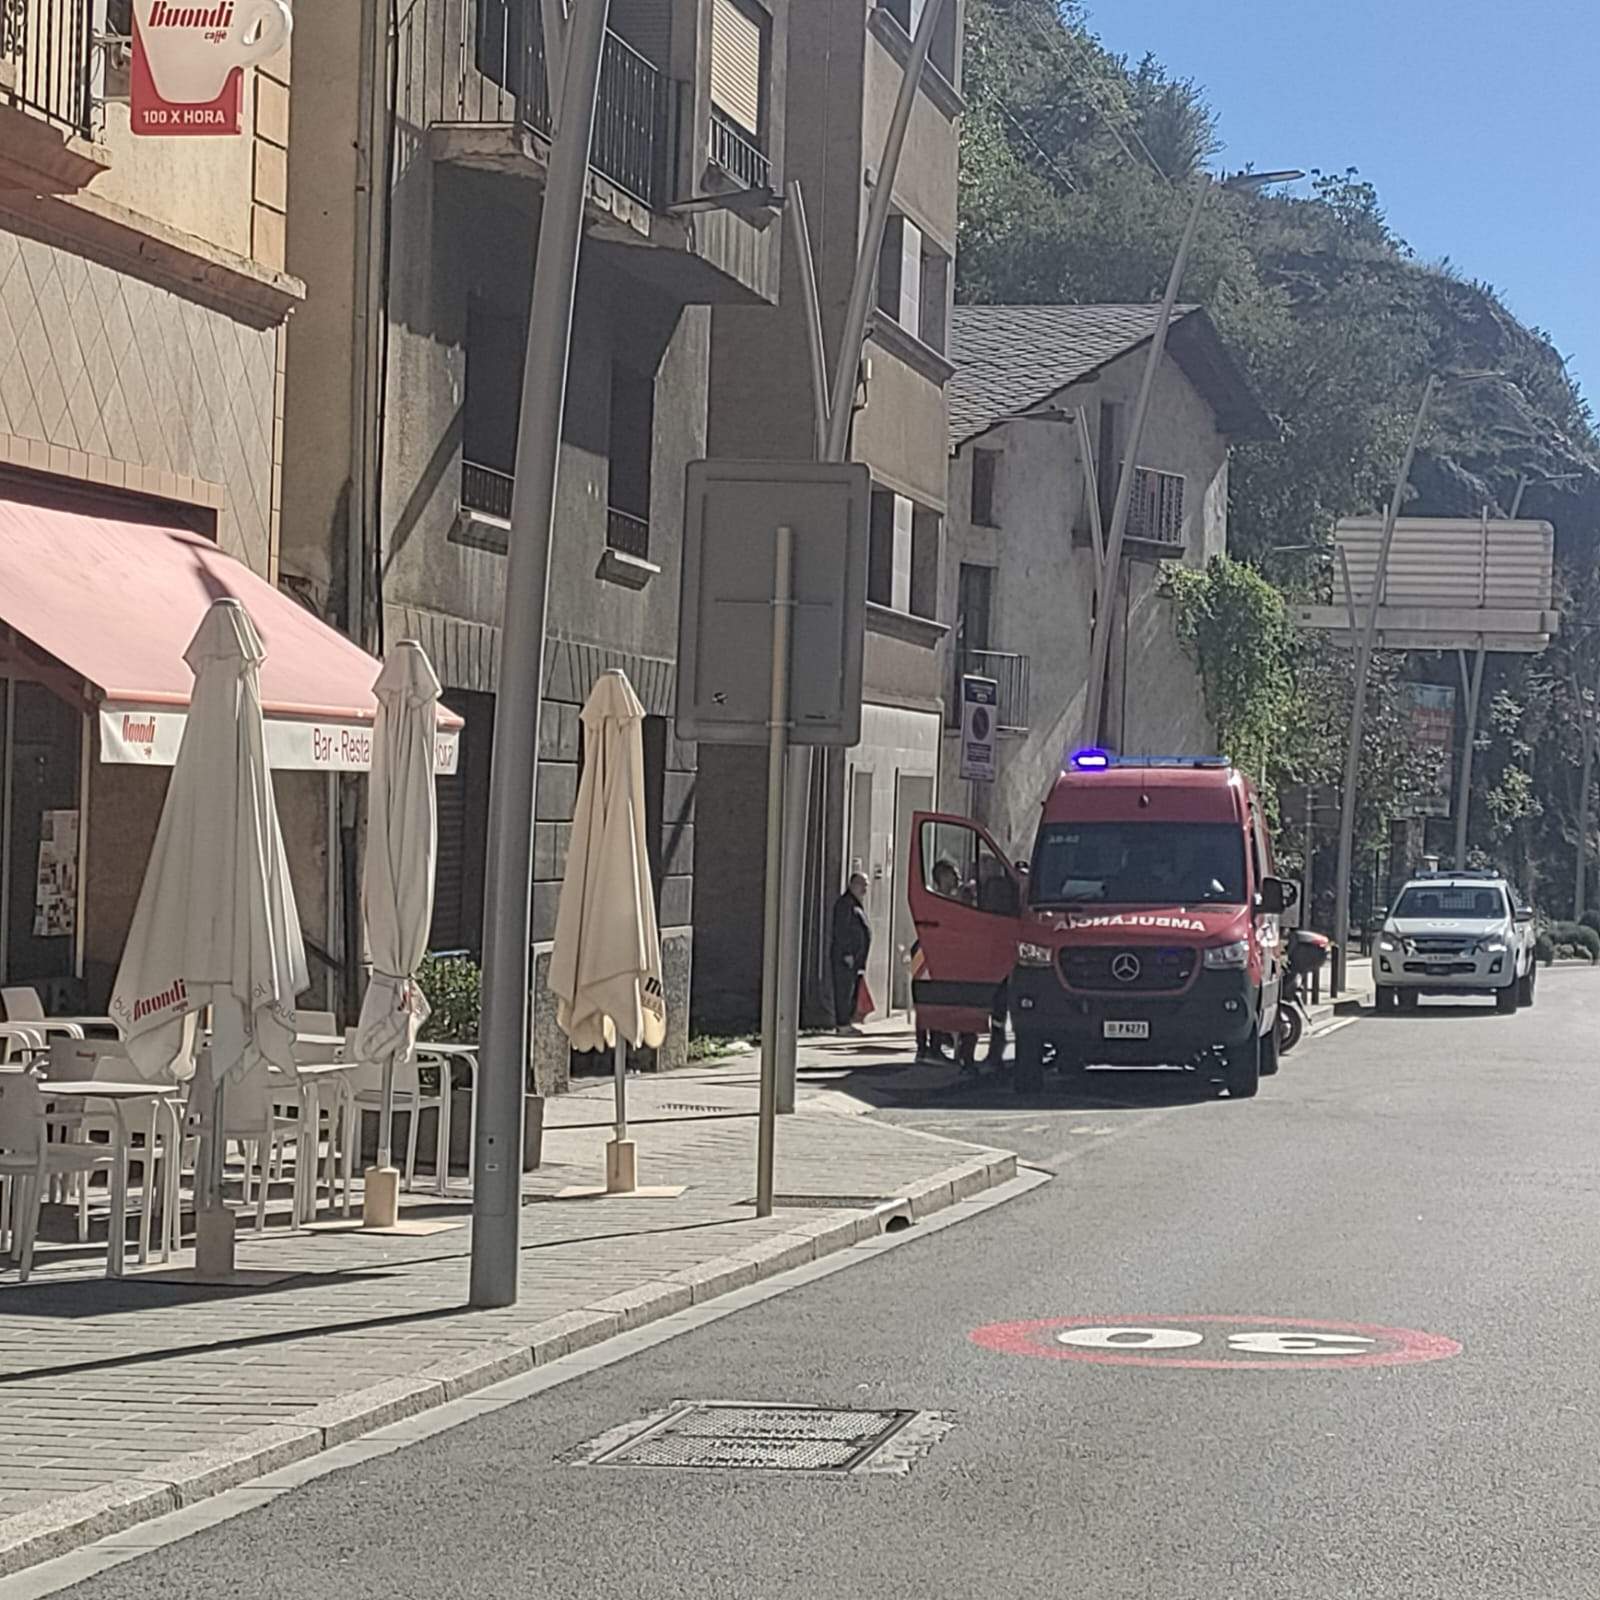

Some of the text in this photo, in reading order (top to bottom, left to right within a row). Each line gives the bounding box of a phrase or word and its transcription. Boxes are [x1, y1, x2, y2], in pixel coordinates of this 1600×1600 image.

[148, 1, 234, 27] Buondi
[143, 110, 225, 123] 100 X HORA
[314, 728, 332, 760] Bar
[341, 730, 370, 762] Resta
[1057, 1326, 1376, 1355] 30
